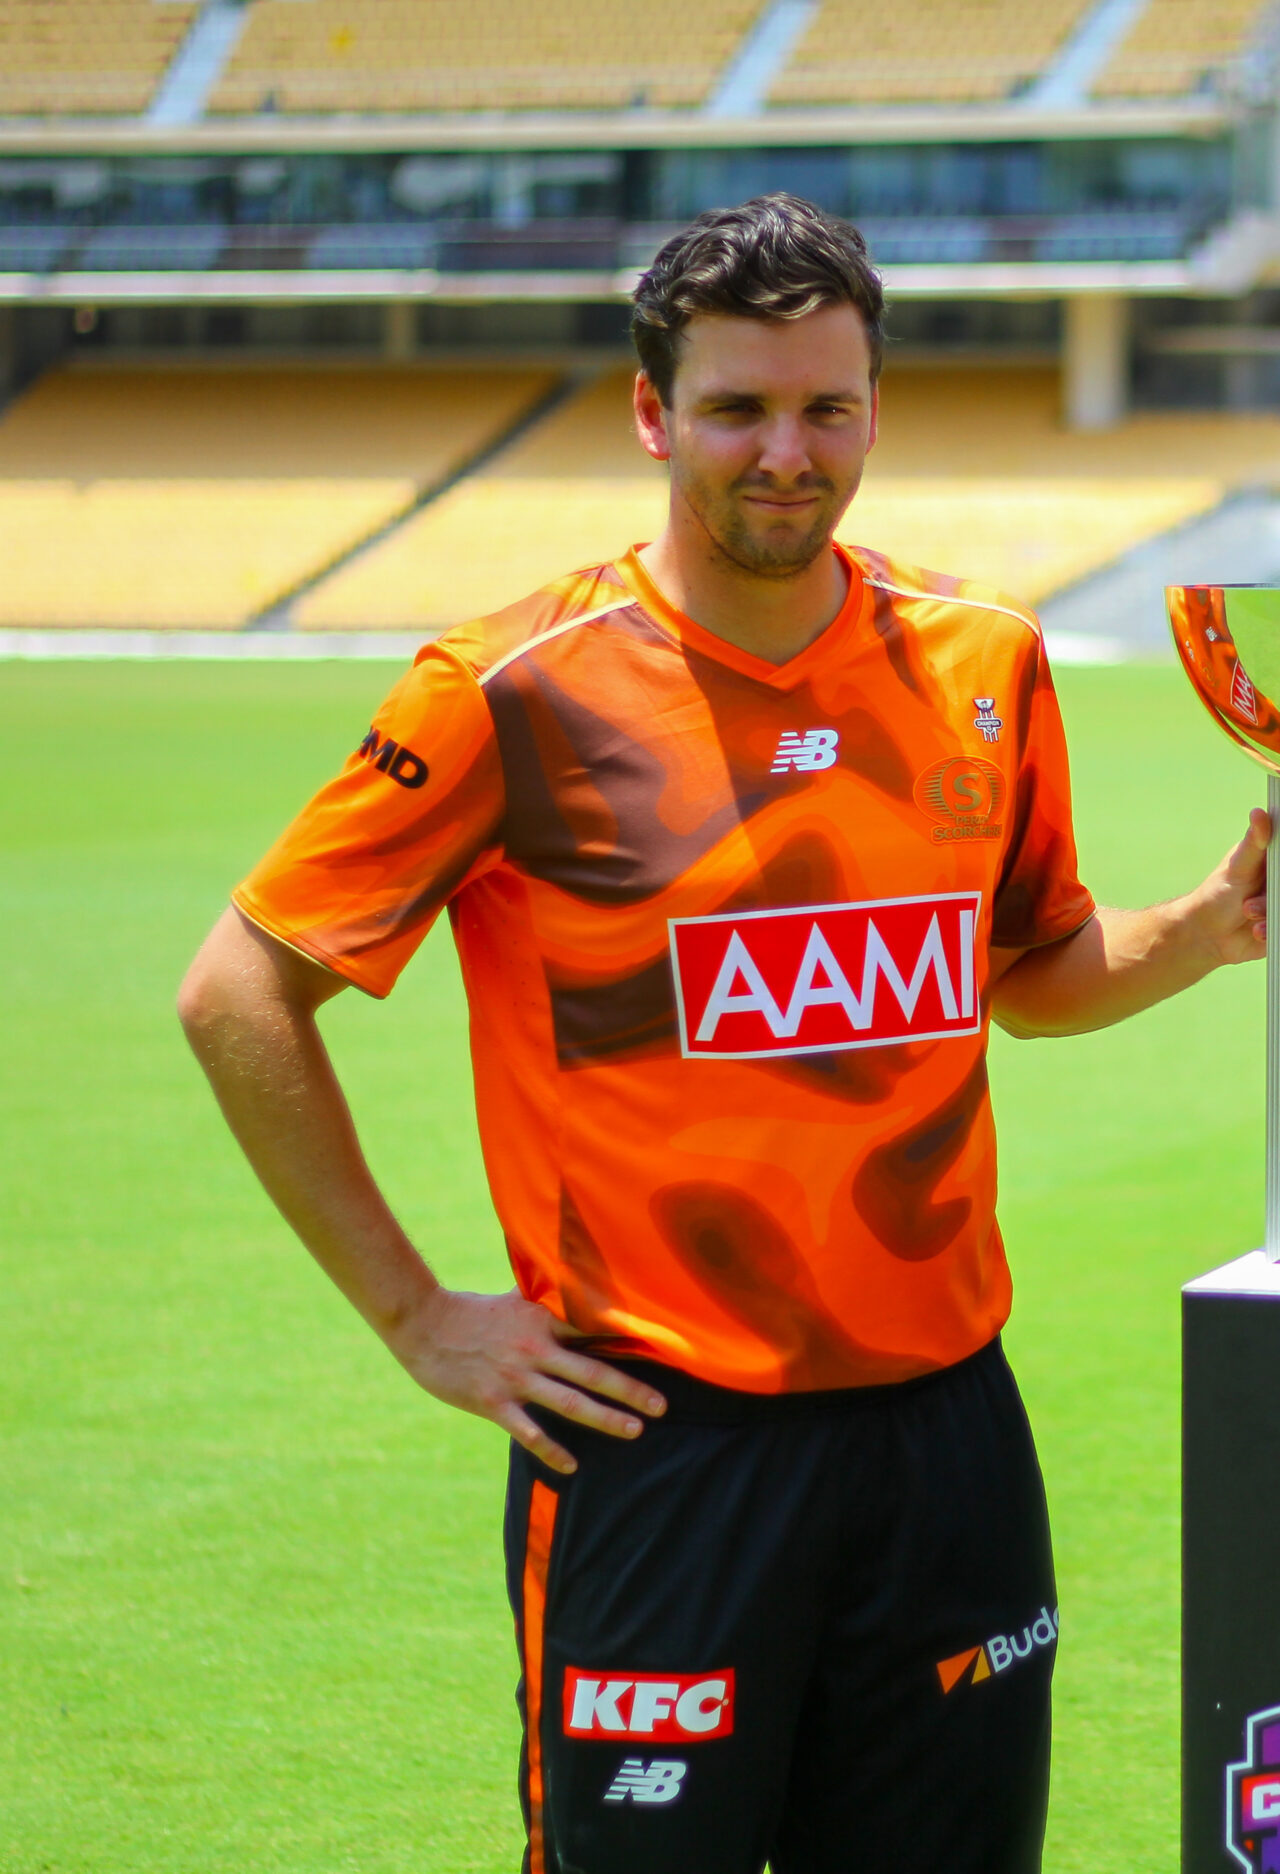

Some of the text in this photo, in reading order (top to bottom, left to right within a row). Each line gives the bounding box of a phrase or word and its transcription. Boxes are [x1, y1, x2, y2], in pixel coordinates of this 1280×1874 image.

[770, 729, 839, 773] NB
[696, 910, 976, 1042] AAMI
[569, 1678, 729, 1733] KFC
[604, 1759, 688, 1803] NB
